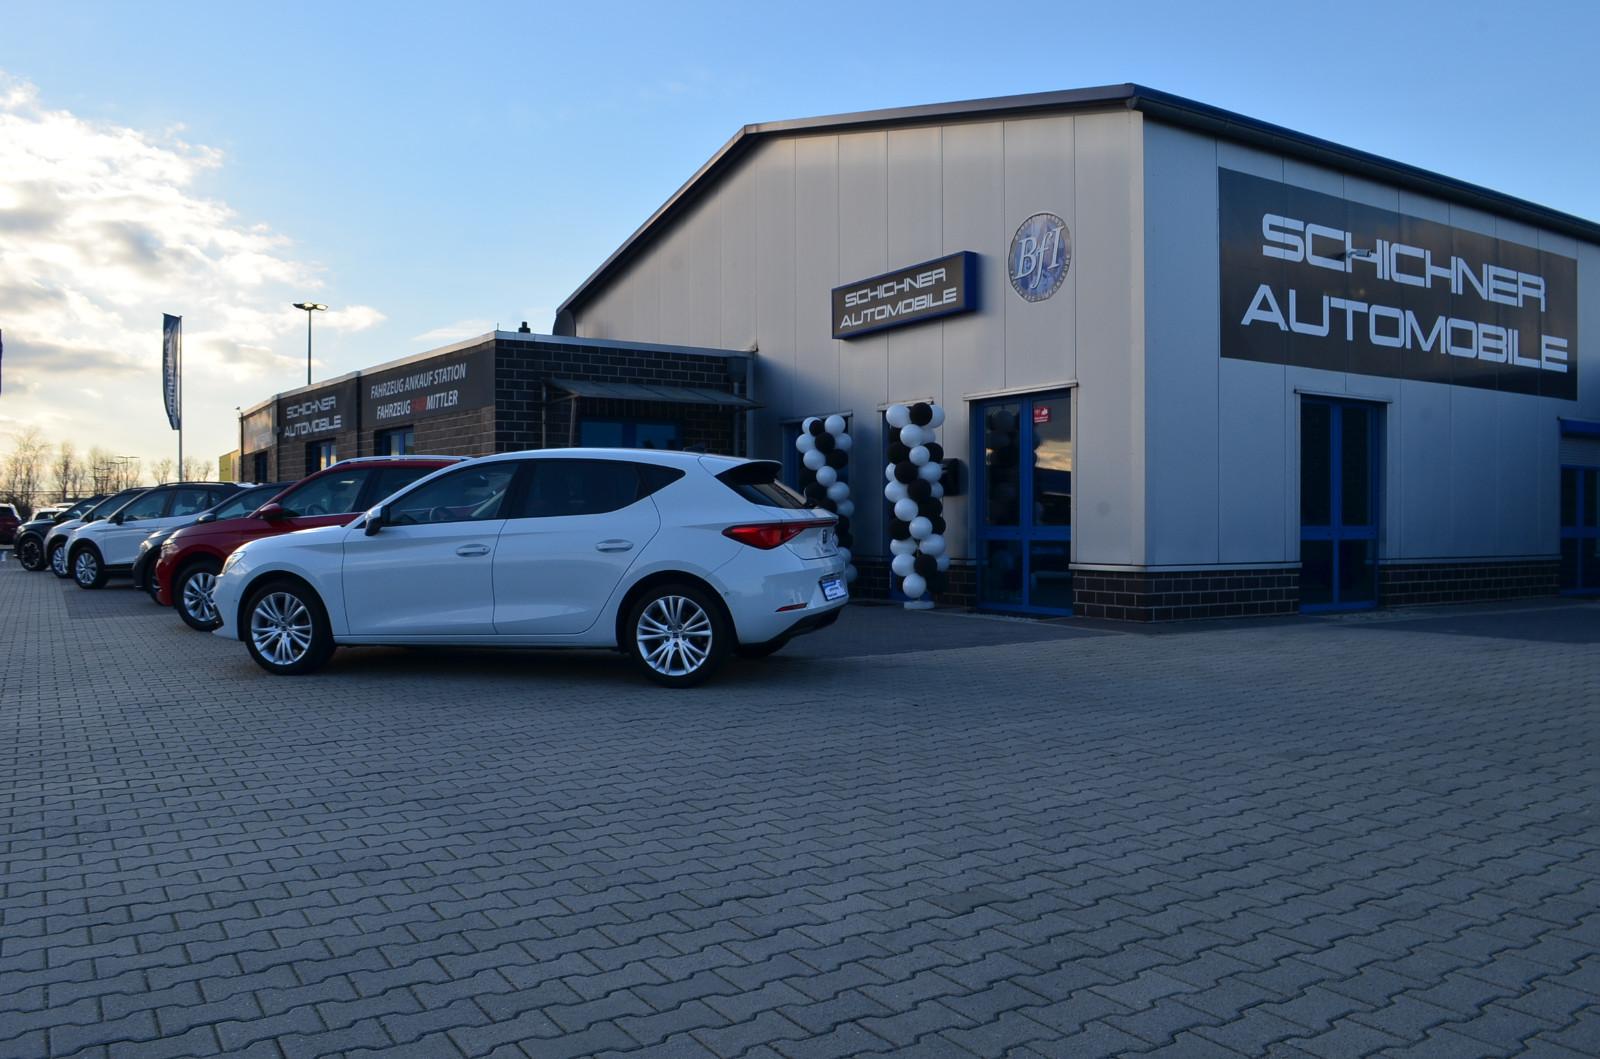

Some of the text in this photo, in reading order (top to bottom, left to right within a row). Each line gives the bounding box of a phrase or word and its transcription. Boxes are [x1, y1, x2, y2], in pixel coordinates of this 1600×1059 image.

[1262, 212, 1546, 312] SCHICHNER
[844, 267, 946, 308] SCHICHNER
[839, 287, 957, 329] AUTOMOBILE
[1241, 284, 1568, 373] AUTOMOBILE
[370, 363, 467, 399] FAHRZEUG ANKAUF STATION
[284, 415, 342, 438] AUTOMOBILE
[286, 396, 337, 419] SCHICHNER
[376, 400, 411, 420] FAHRZEUG
